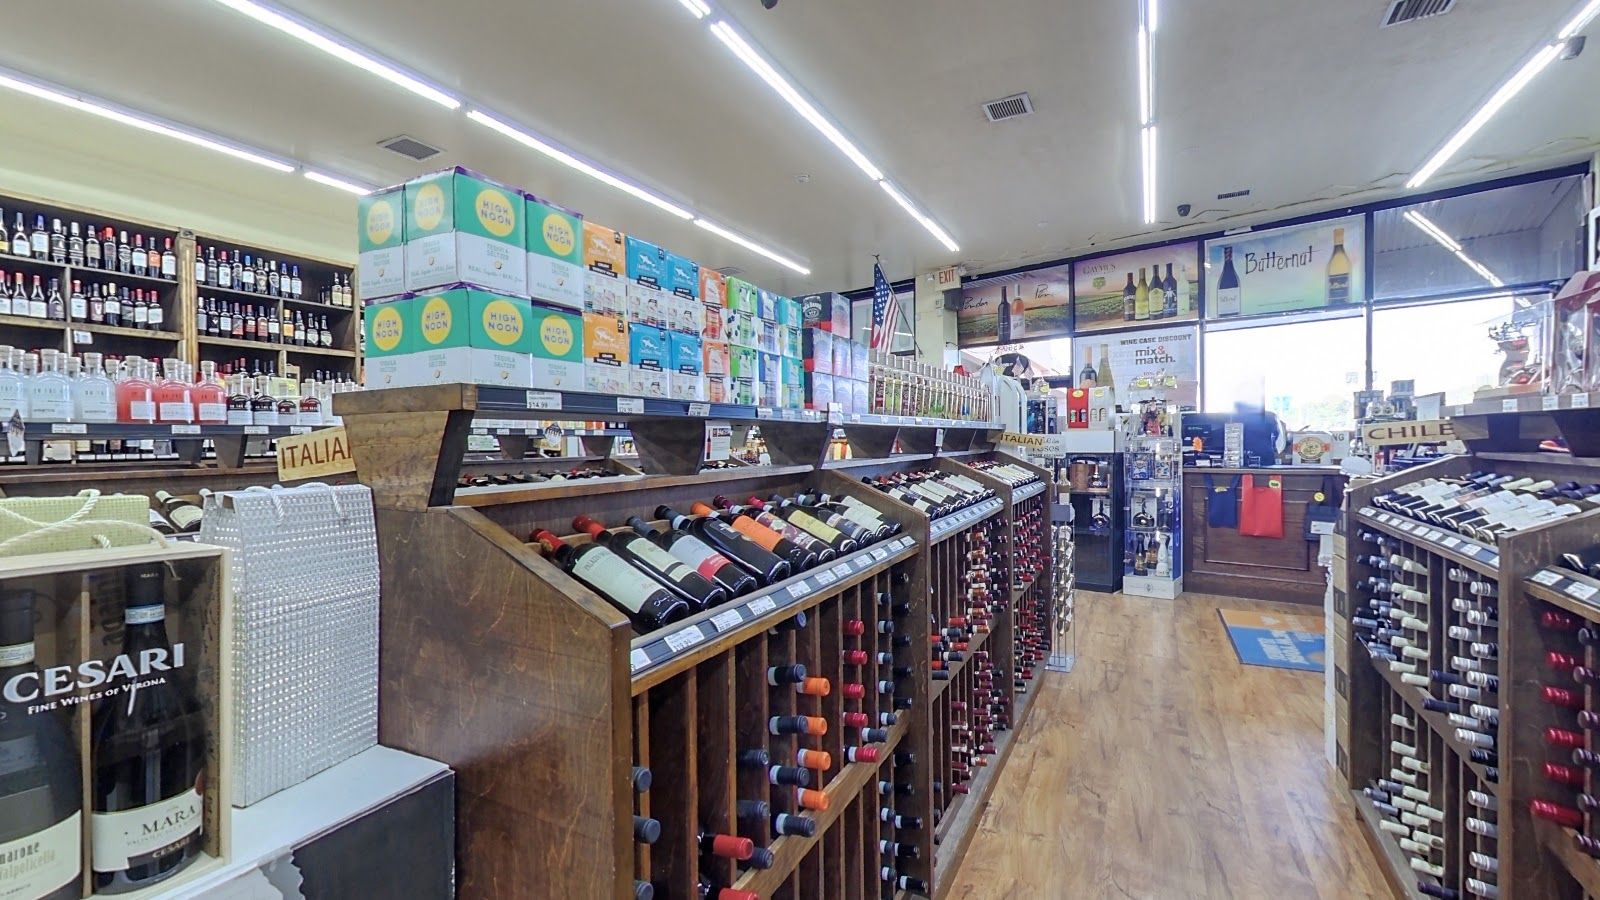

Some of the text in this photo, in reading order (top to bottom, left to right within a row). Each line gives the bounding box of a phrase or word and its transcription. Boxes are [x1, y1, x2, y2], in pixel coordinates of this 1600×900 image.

[482, 200, 508, 213] HIGH
[480, 209, 512, 226] NOON
[548, 223, 569, 238] HIGH
[546, 232, 572, 246] NOON
[1245, 245, 1319, 274] Butternut
[939, 269, 954, 284] EXIT
[426, 310, 446, 320] HIGH
[490, 312, 516, 322] HIGH
[378, 320, 397, 328] HIGH
[425, 320, 448, 331] NOON
[488, 322, 519, 332] NOON
[376, 329, 400, 338] NOON
[546, 326, 568, 336] HIGH
[544, 334, 570, 344] NOON
[1120, 334, 1192, 346] WINE CASE DISCOUNT
[1136, 354, 1176, 365] match.
[1368, 422, 1455, 440] CHILE
[1000, 434, 1043, 446] ITALIAN
[2, 642, 184, 703] CESARI
[28, 702, 58, 715] FINE
[60, 691, 103, 707] WINES
[104, 688, 120, 697] OF
[142, 805, 196, 836] MARA
